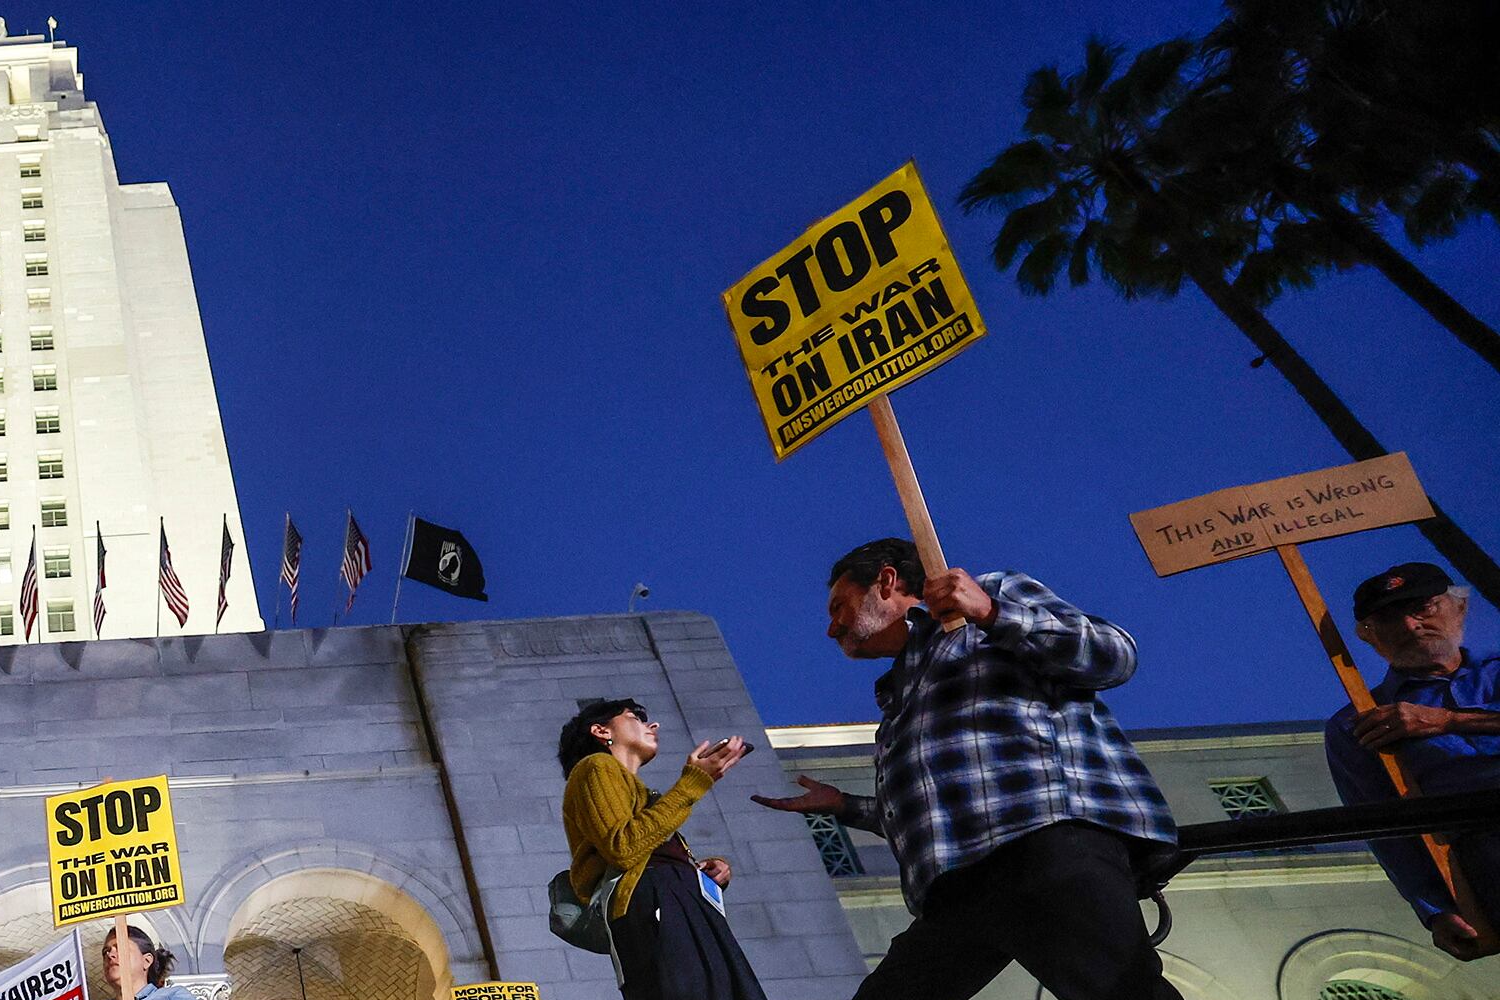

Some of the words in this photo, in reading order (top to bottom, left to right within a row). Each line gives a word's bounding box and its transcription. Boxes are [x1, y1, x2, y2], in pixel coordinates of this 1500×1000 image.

[742, 190, 911, 345] STOP
[761, 325, 835, 377] THE
[840, 258, 940, 324] WAR
[772, 352, 832, 417] ON
[838, 277, 954, 372] IRAN
[783, 320, 966, 443] ANSWERCOALITION.ORG
[1156, 518, 1215, 545] THIS
[1218, 503, 1274, 526] WAR
[1287, 497, 1305, 511] IS
[1306, 474, 1394, 506] WRONG
[1212, 532, 1255, 552] AND
[1274, 508, 1364, 534] ILLEGAL
[55, 786, 161, 846] STOP
[58, 852, 105, 869] THE
[110, 842, 169, 859] WAR
[61, 869, 97, 900] ON
[106, 856, 171, 891] IRAN
[62, 887, 175, 917] ANSWERCOALITION.ORG
[455, 986, 504, 997] MONEY
